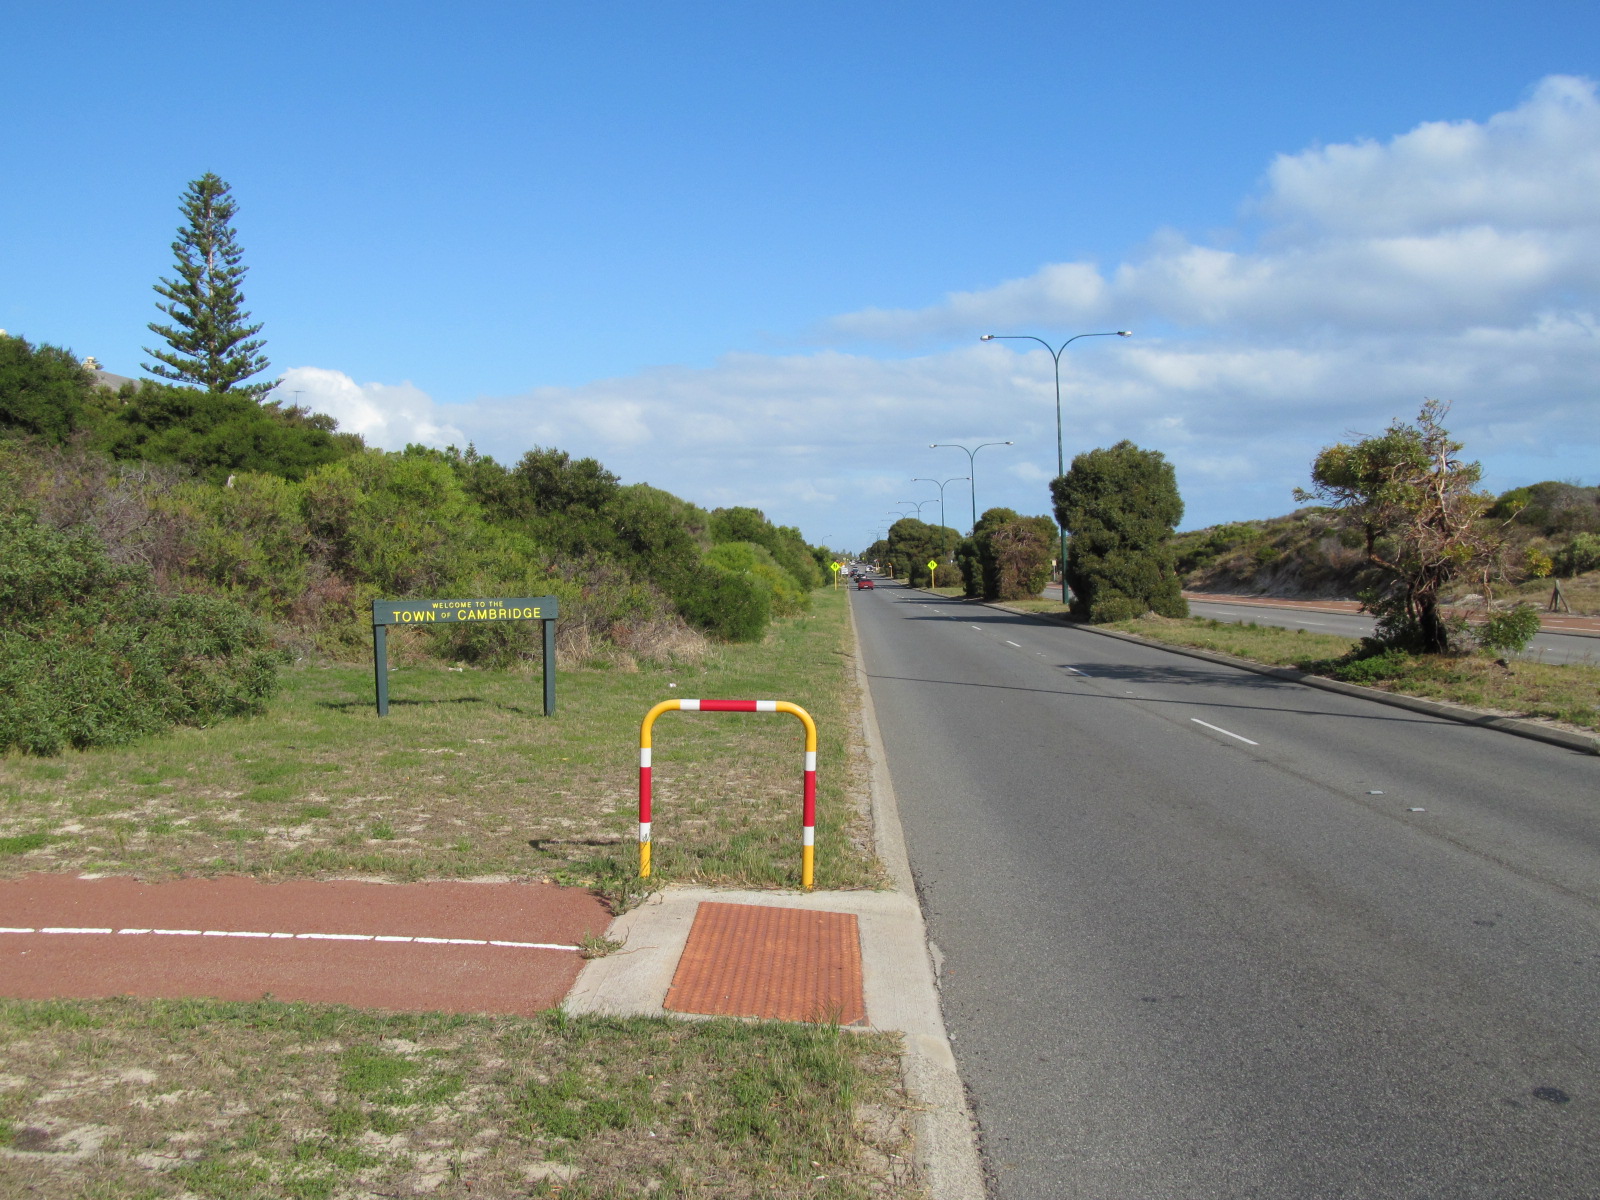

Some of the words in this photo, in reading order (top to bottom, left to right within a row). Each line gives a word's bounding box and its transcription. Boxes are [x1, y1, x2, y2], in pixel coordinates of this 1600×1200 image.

[432, 601, 472, 609] WELCOME
[489, 600, 504, 608] THE
[393, 610, 436, 623] TOWN
[457, 607, 541, 620] CAMBRIDGE
